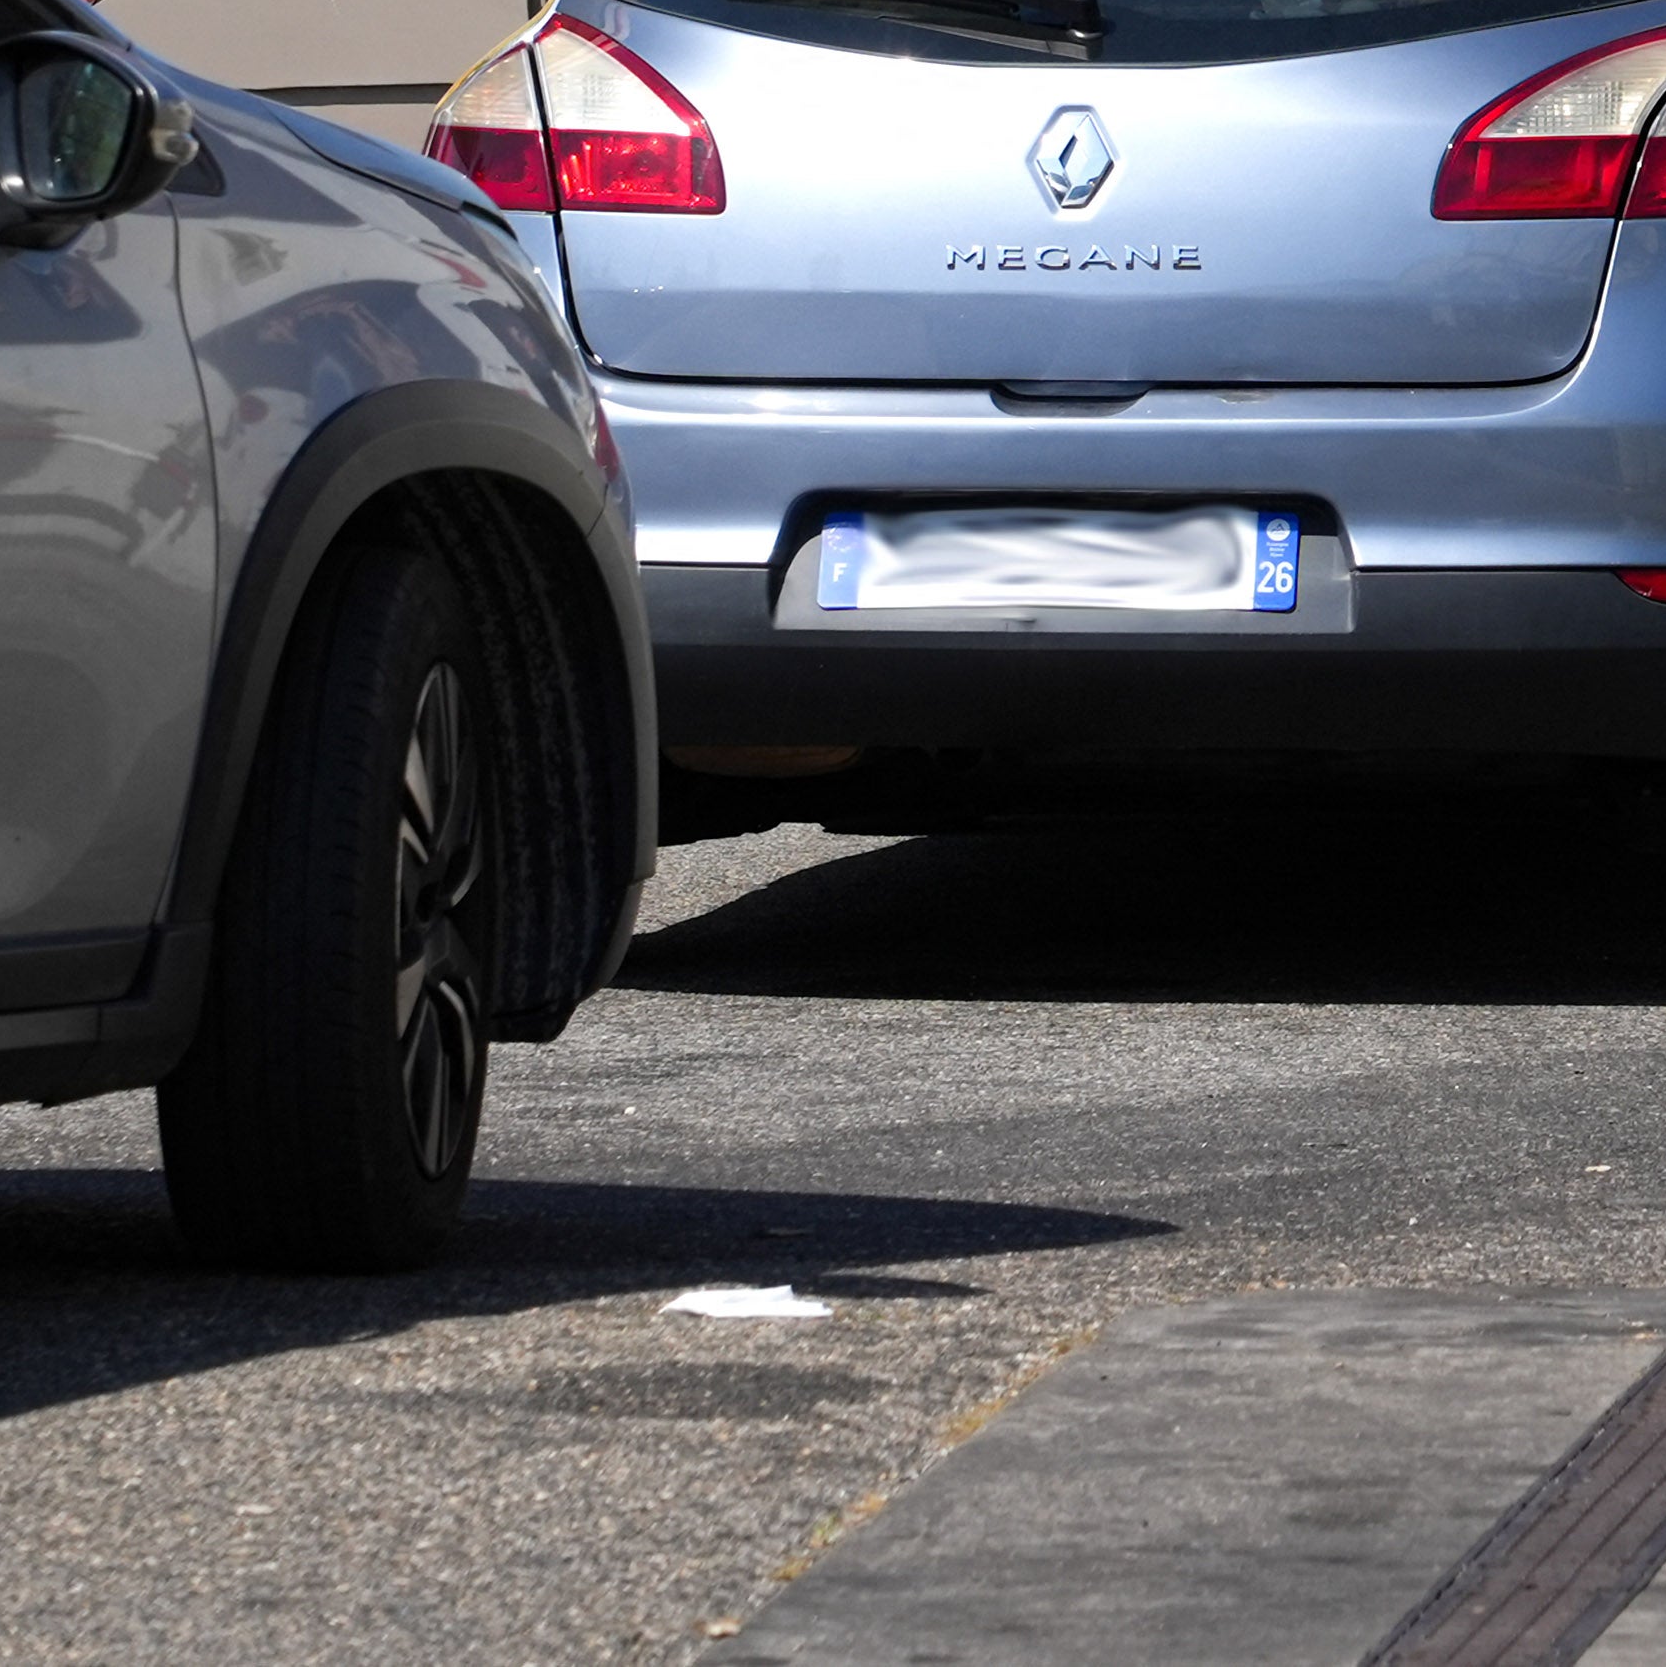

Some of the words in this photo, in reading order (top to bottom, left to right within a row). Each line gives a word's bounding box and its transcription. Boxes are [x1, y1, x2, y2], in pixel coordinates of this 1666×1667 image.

[945, 244, 1203, 271] MEGANE
[833, 562, 848, 583] F
[1256, 560, 1294, 594] 26
